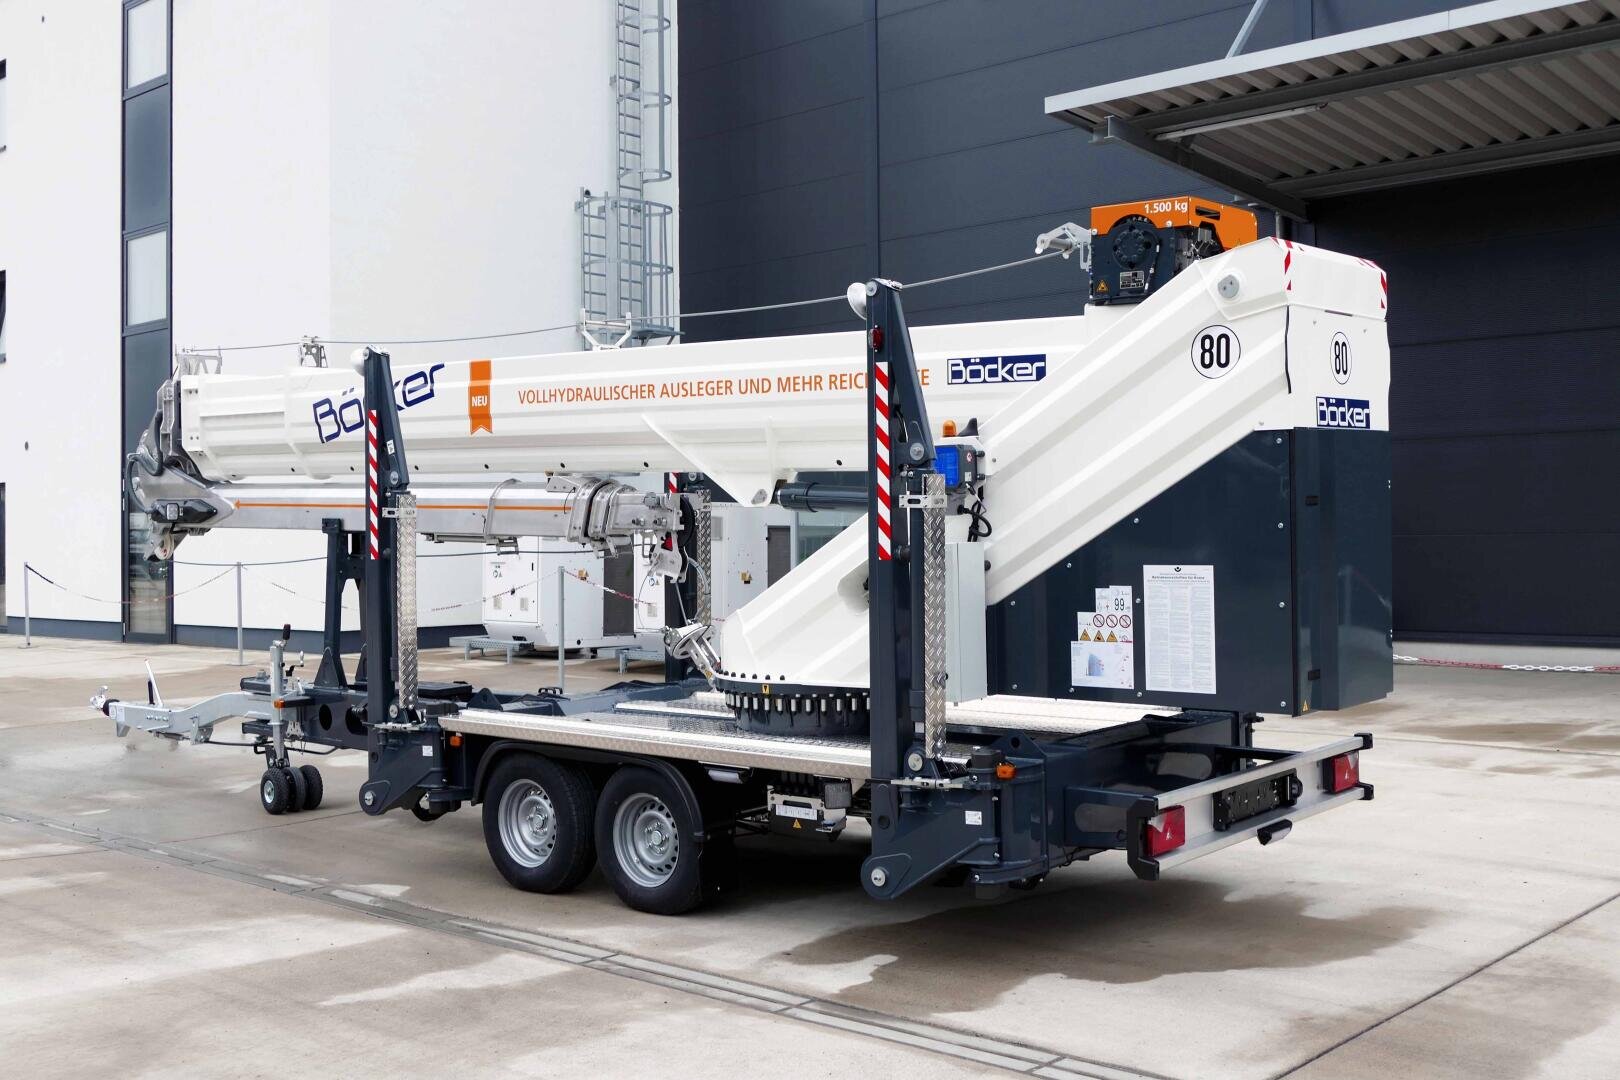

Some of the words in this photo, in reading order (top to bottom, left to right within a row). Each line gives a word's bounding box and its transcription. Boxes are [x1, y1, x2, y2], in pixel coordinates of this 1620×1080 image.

[1144, 201, 1172, 214] 1.500
[1174, 200, 1188, 212] kg
[1200, 333, 1230, 369] 80
[1334, 340, 1348, 376] 80
[947, 357, 1045, 384] Böcker
[313, 363, 445, 444] Böer
[471, 395, 488, 407] NEU
[518, 384, 656, 405] VOLLHYDRAULISCHER
[660, 379, 733, 398] AUSLEGER
[738, 377, 772, 395] UND
[777, 375, 823, 393] MEHR
[1316, 397, 1370, 428] Böcker
[1114, 598, 1125, 611] 99
